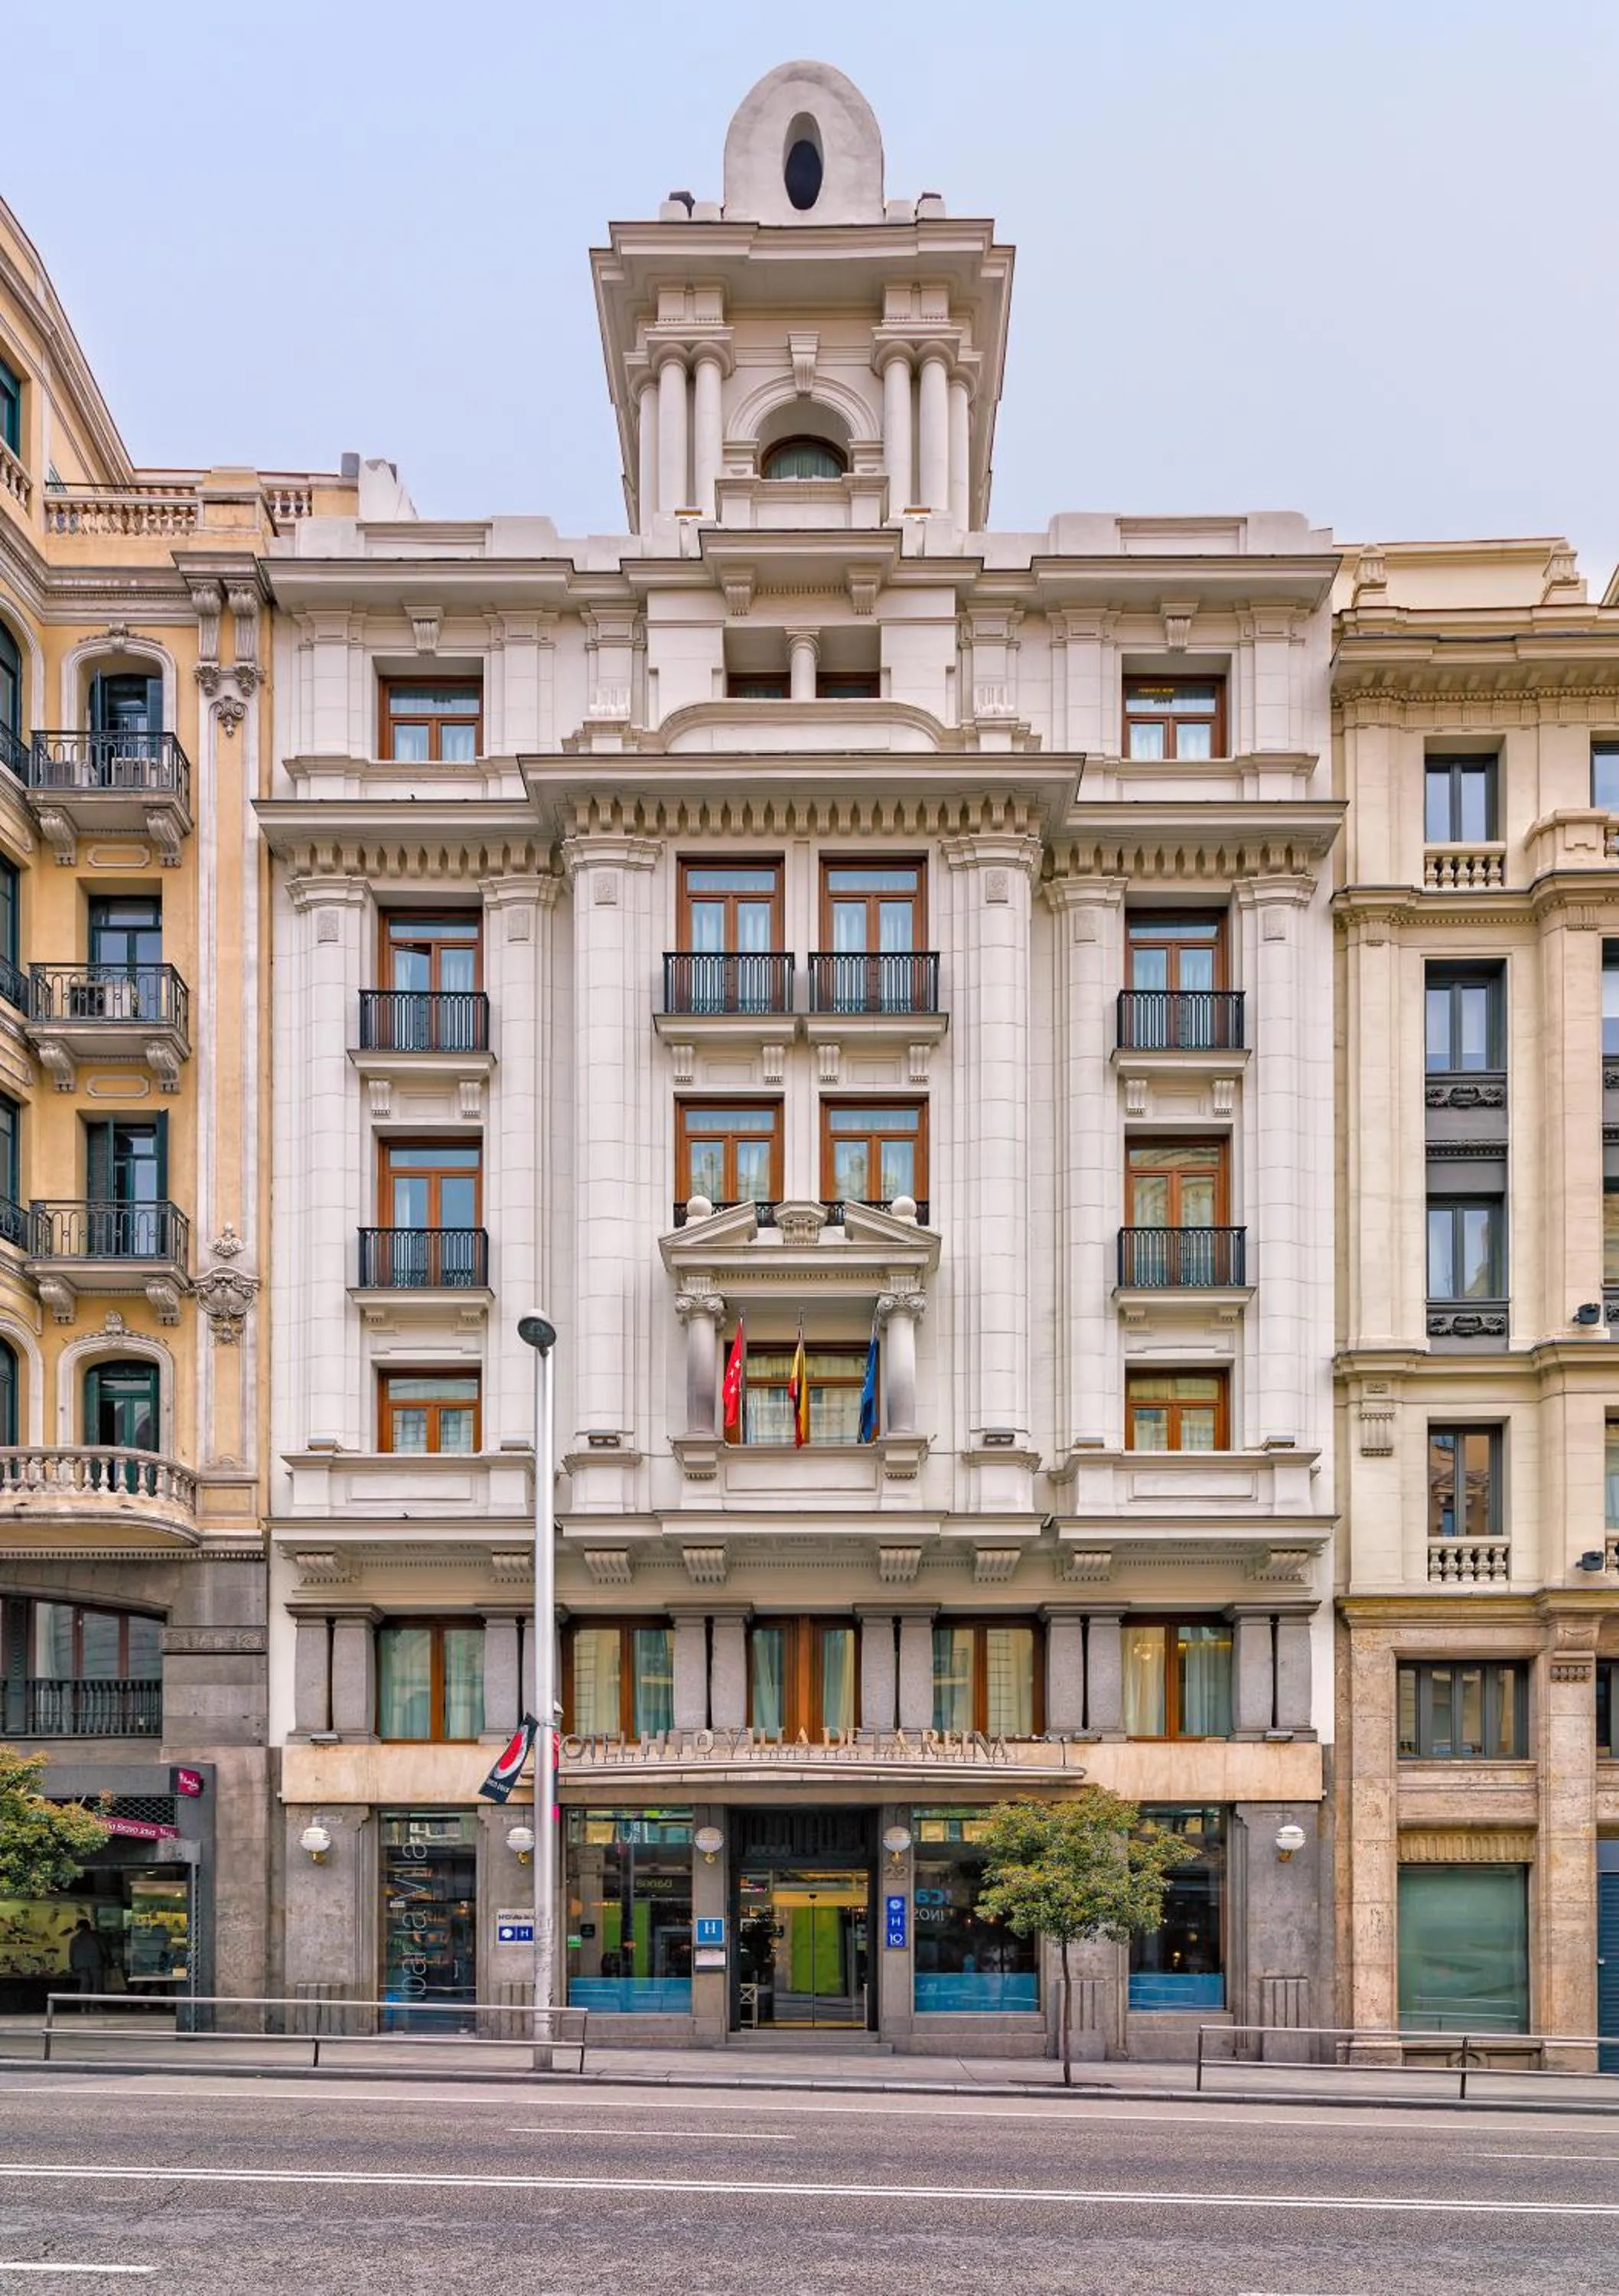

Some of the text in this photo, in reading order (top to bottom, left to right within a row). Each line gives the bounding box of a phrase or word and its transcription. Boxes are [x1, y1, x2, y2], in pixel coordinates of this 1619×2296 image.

[559, 1730, 636, 1760] OTEL
[917, 1728, 1012, 1760] REINA
[703, 1921, 716, 1935] H
[402, 1950, 427, 1995] bar
